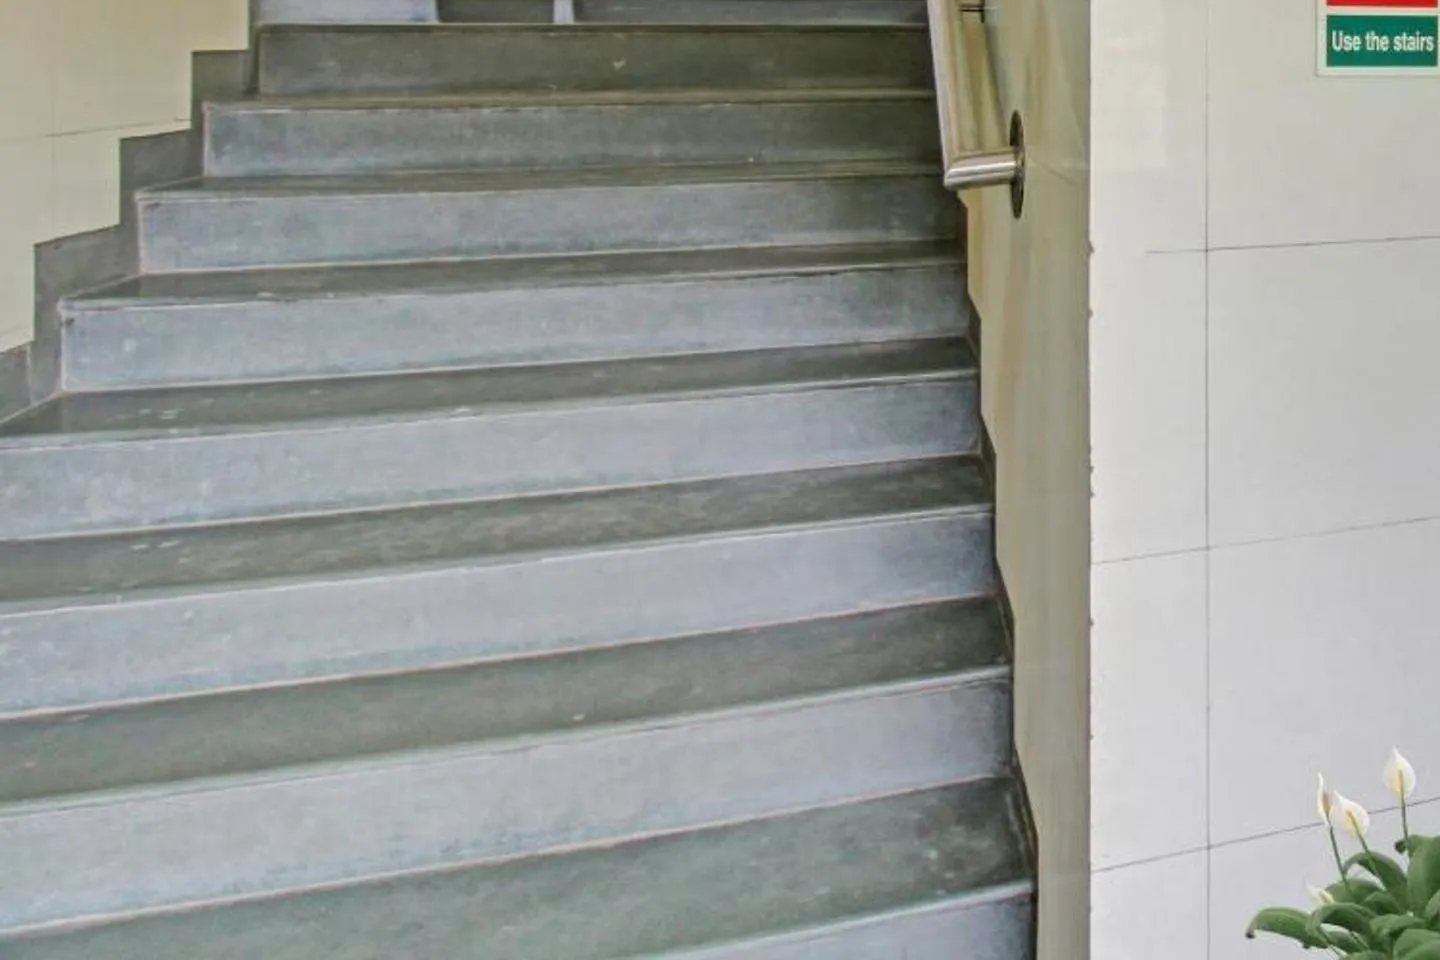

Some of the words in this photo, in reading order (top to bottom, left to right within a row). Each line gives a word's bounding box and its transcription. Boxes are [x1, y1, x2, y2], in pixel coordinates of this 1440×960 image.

[1331, 31, 1361, 51] Use
[1365, 31, 1391, 52] the
[1393, 32, 1435, 52] stairs
